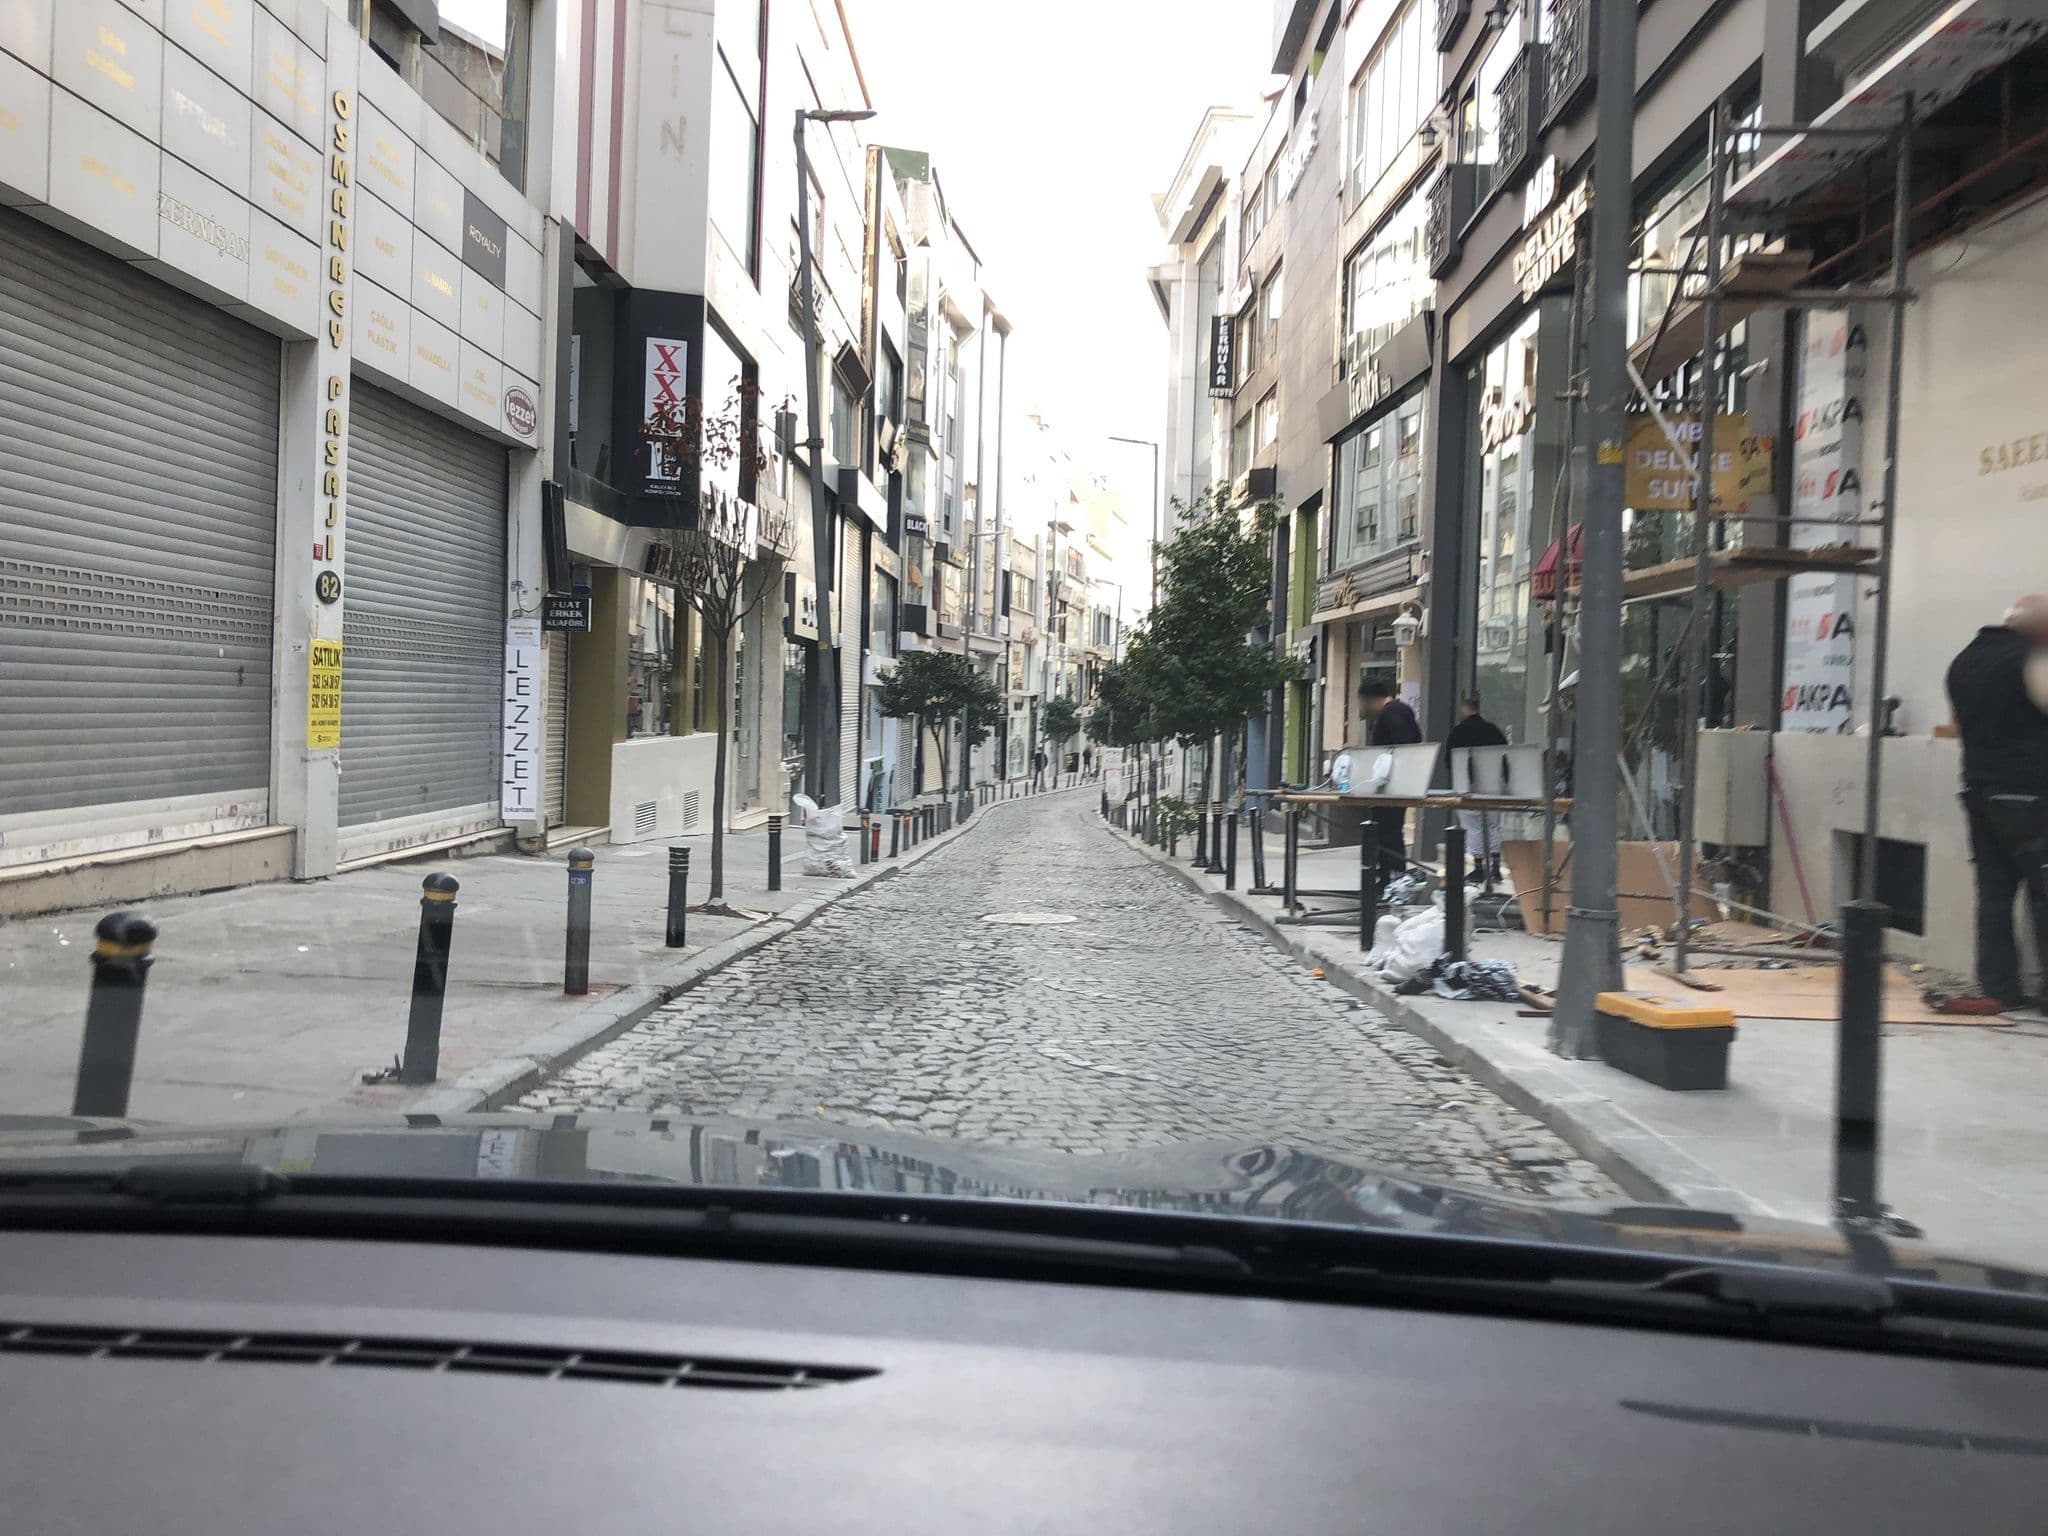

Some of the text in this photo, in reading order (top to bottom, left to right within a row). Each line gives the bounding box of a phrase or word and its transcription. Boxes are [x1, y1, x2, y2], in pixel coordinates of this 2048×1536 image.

[468, 224, 502, 258] ROYALTY
[1513, 176, 1590, 286] DELUXE
[1522, 222, 1577, 305] SUITE
[324, 90, 350, 561] OSMANBEY PASAJI
[505, 394, 536, 428] lezzet
[319, 575, 339, 599] 82
[550, 610, 583, 618] ERKEK
[552, 600, 580, 609] FUAT
[312, 647, 341, 667] SATILIK
[511, 649, 531, 806] LEZZET
